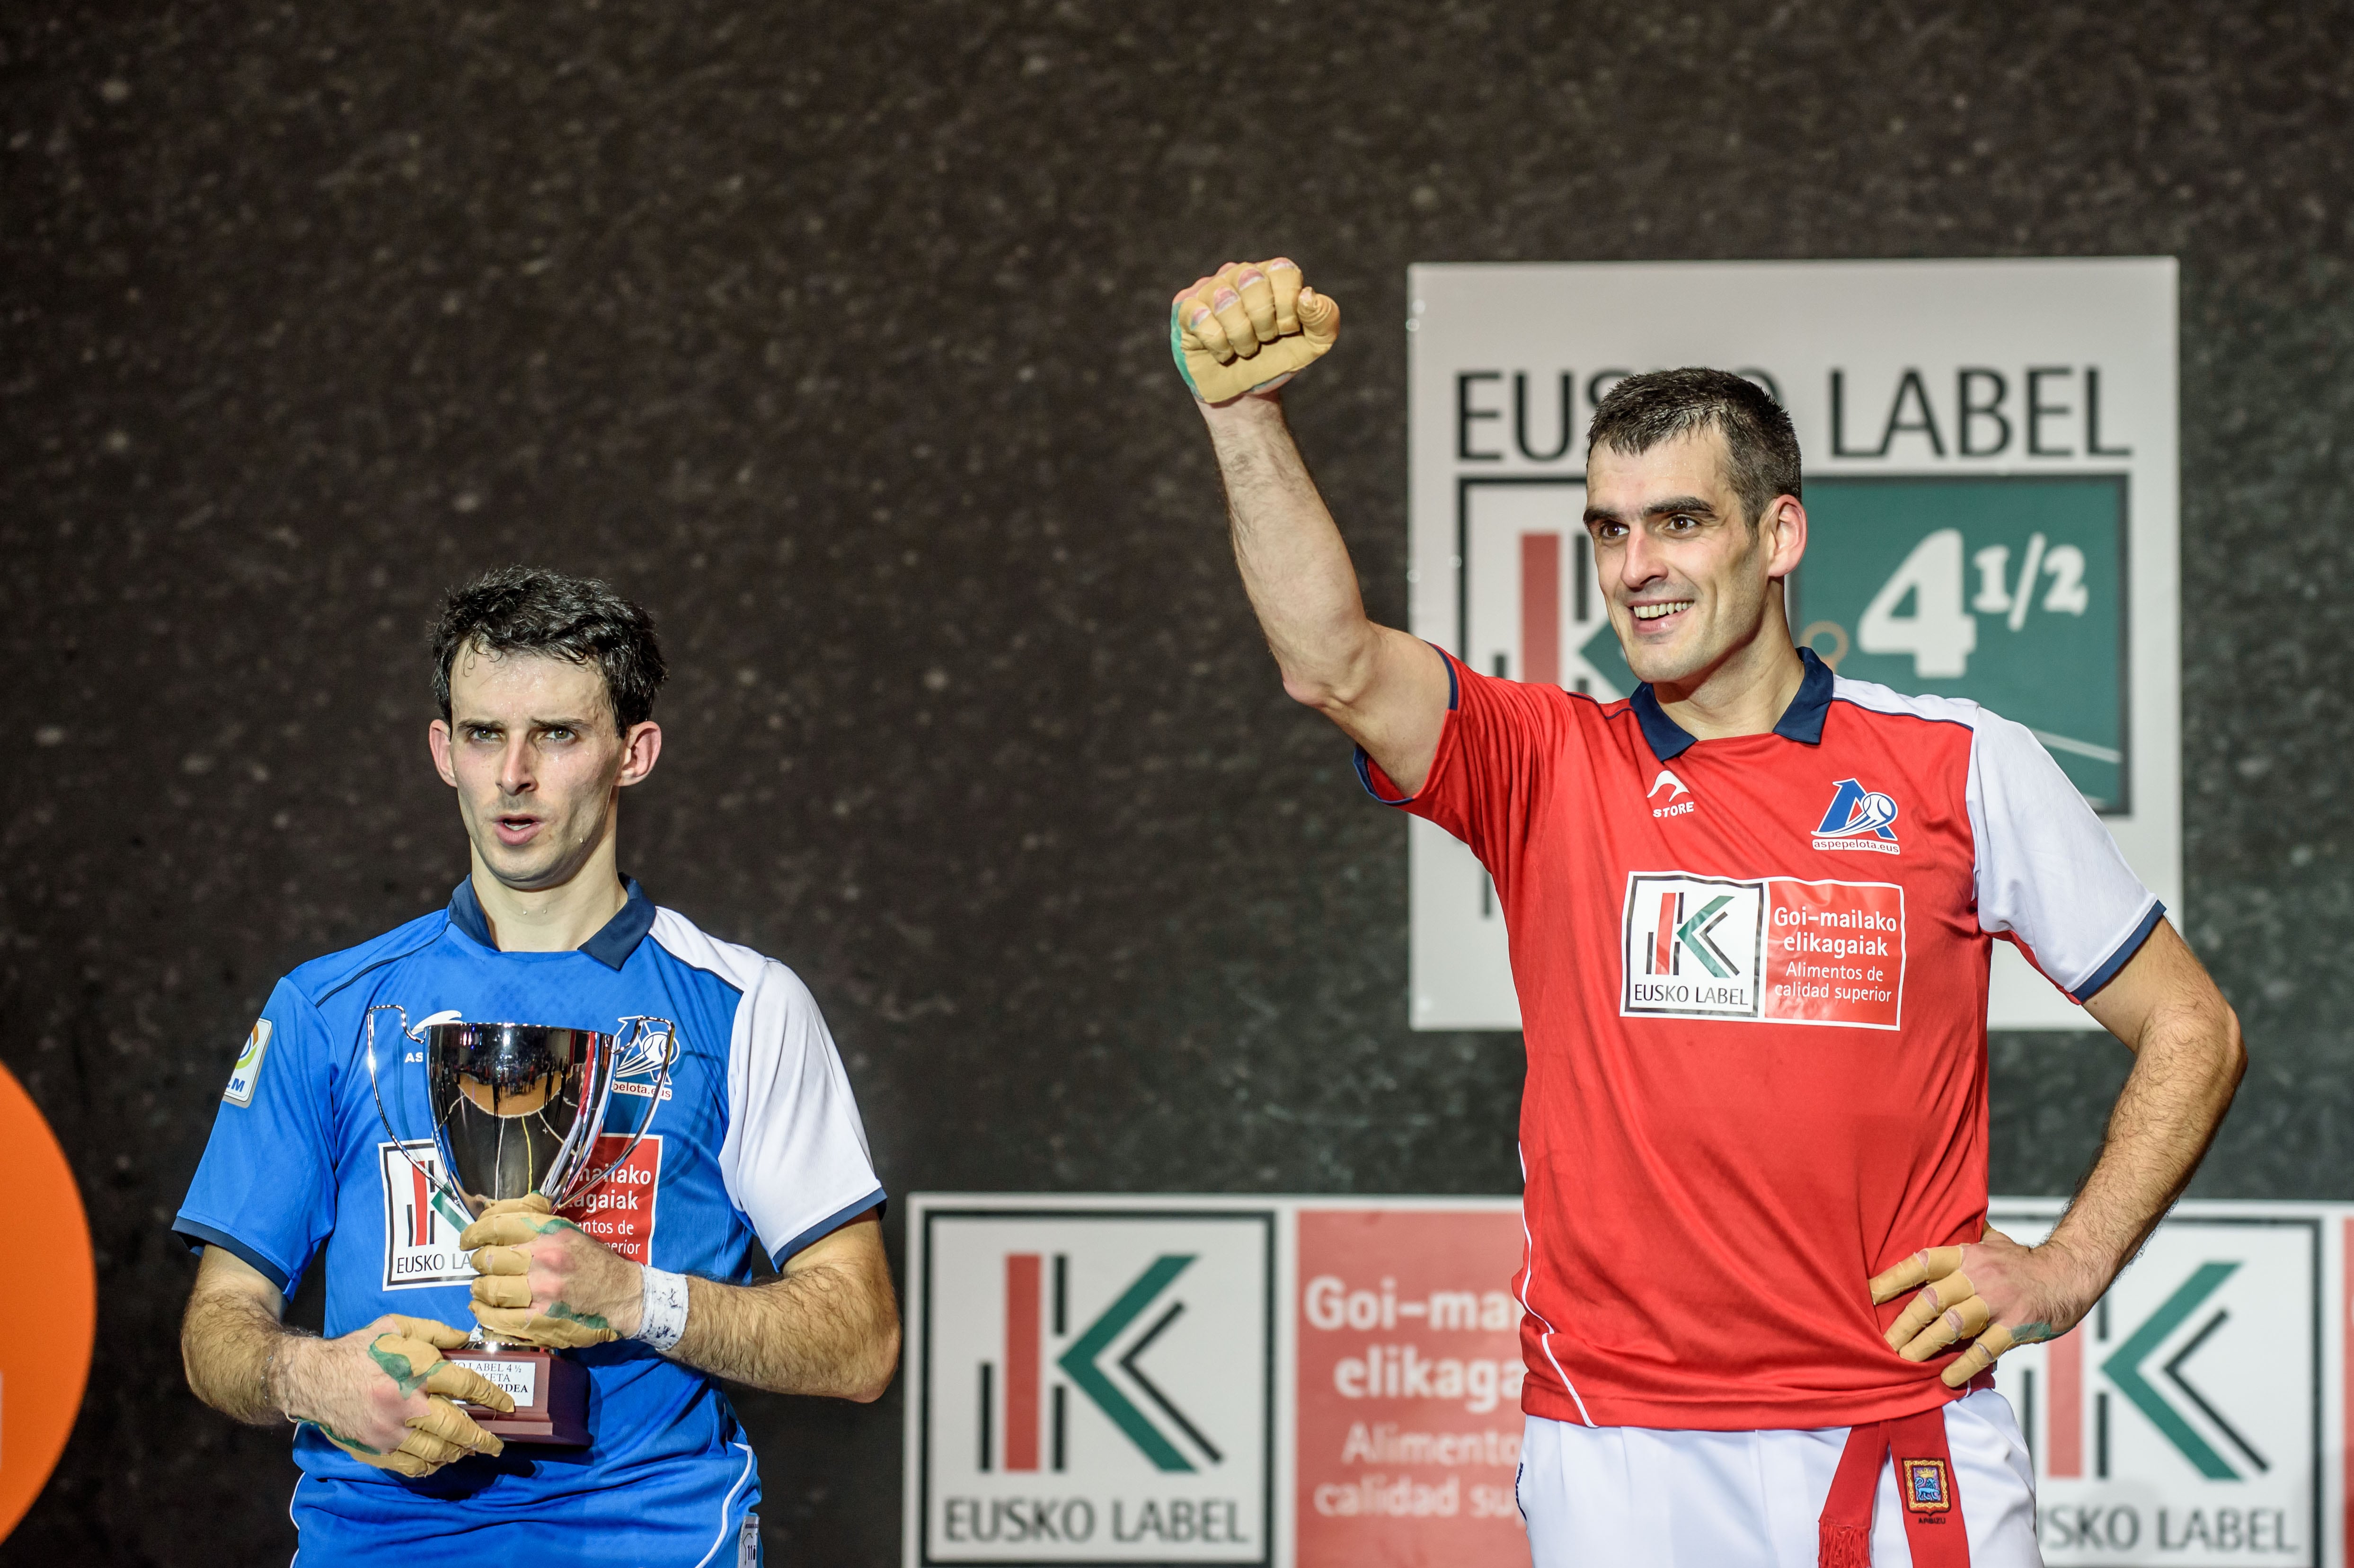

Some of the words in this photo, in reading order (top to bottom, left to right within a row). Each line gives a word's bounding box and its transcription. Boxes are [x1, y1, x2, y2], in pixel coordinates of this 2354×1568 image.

[1829, 364, 2133, 458] LABEL
[1813, 838, 1899, 854] aspepelota.eus
[1774, 906, 1897, 932] Goi-mailako
[1783, 931, 1888, 959] elikagaiak
[1785, 961, 1863, 981] Alimentos
[1867, 966, 1883, 982] de
[1634, 984, 1689, 1002] EUSKO
[1695, 986, 1749, 1006] LABEL
[1774, 981, 1829, 998] calidad
[1834, 986, 1892, 1004] superior
[618, 1220, 634, 1235] de
[397, 1254, 445, 1274] EUSKO
[482, 1373, 510, 1382] KETA
[1333, 1343, 1529, 1414] elikaga
[1340, 1421, 1522, 1466] Alimento
[1313, 1472, 1460, 1518] calidad
[944, 1497, 1096, 1544] EUSKO
[1112, 1497, 1249, 1544] LABEL
[2156, 1506, 2302, 1554] LABEL
